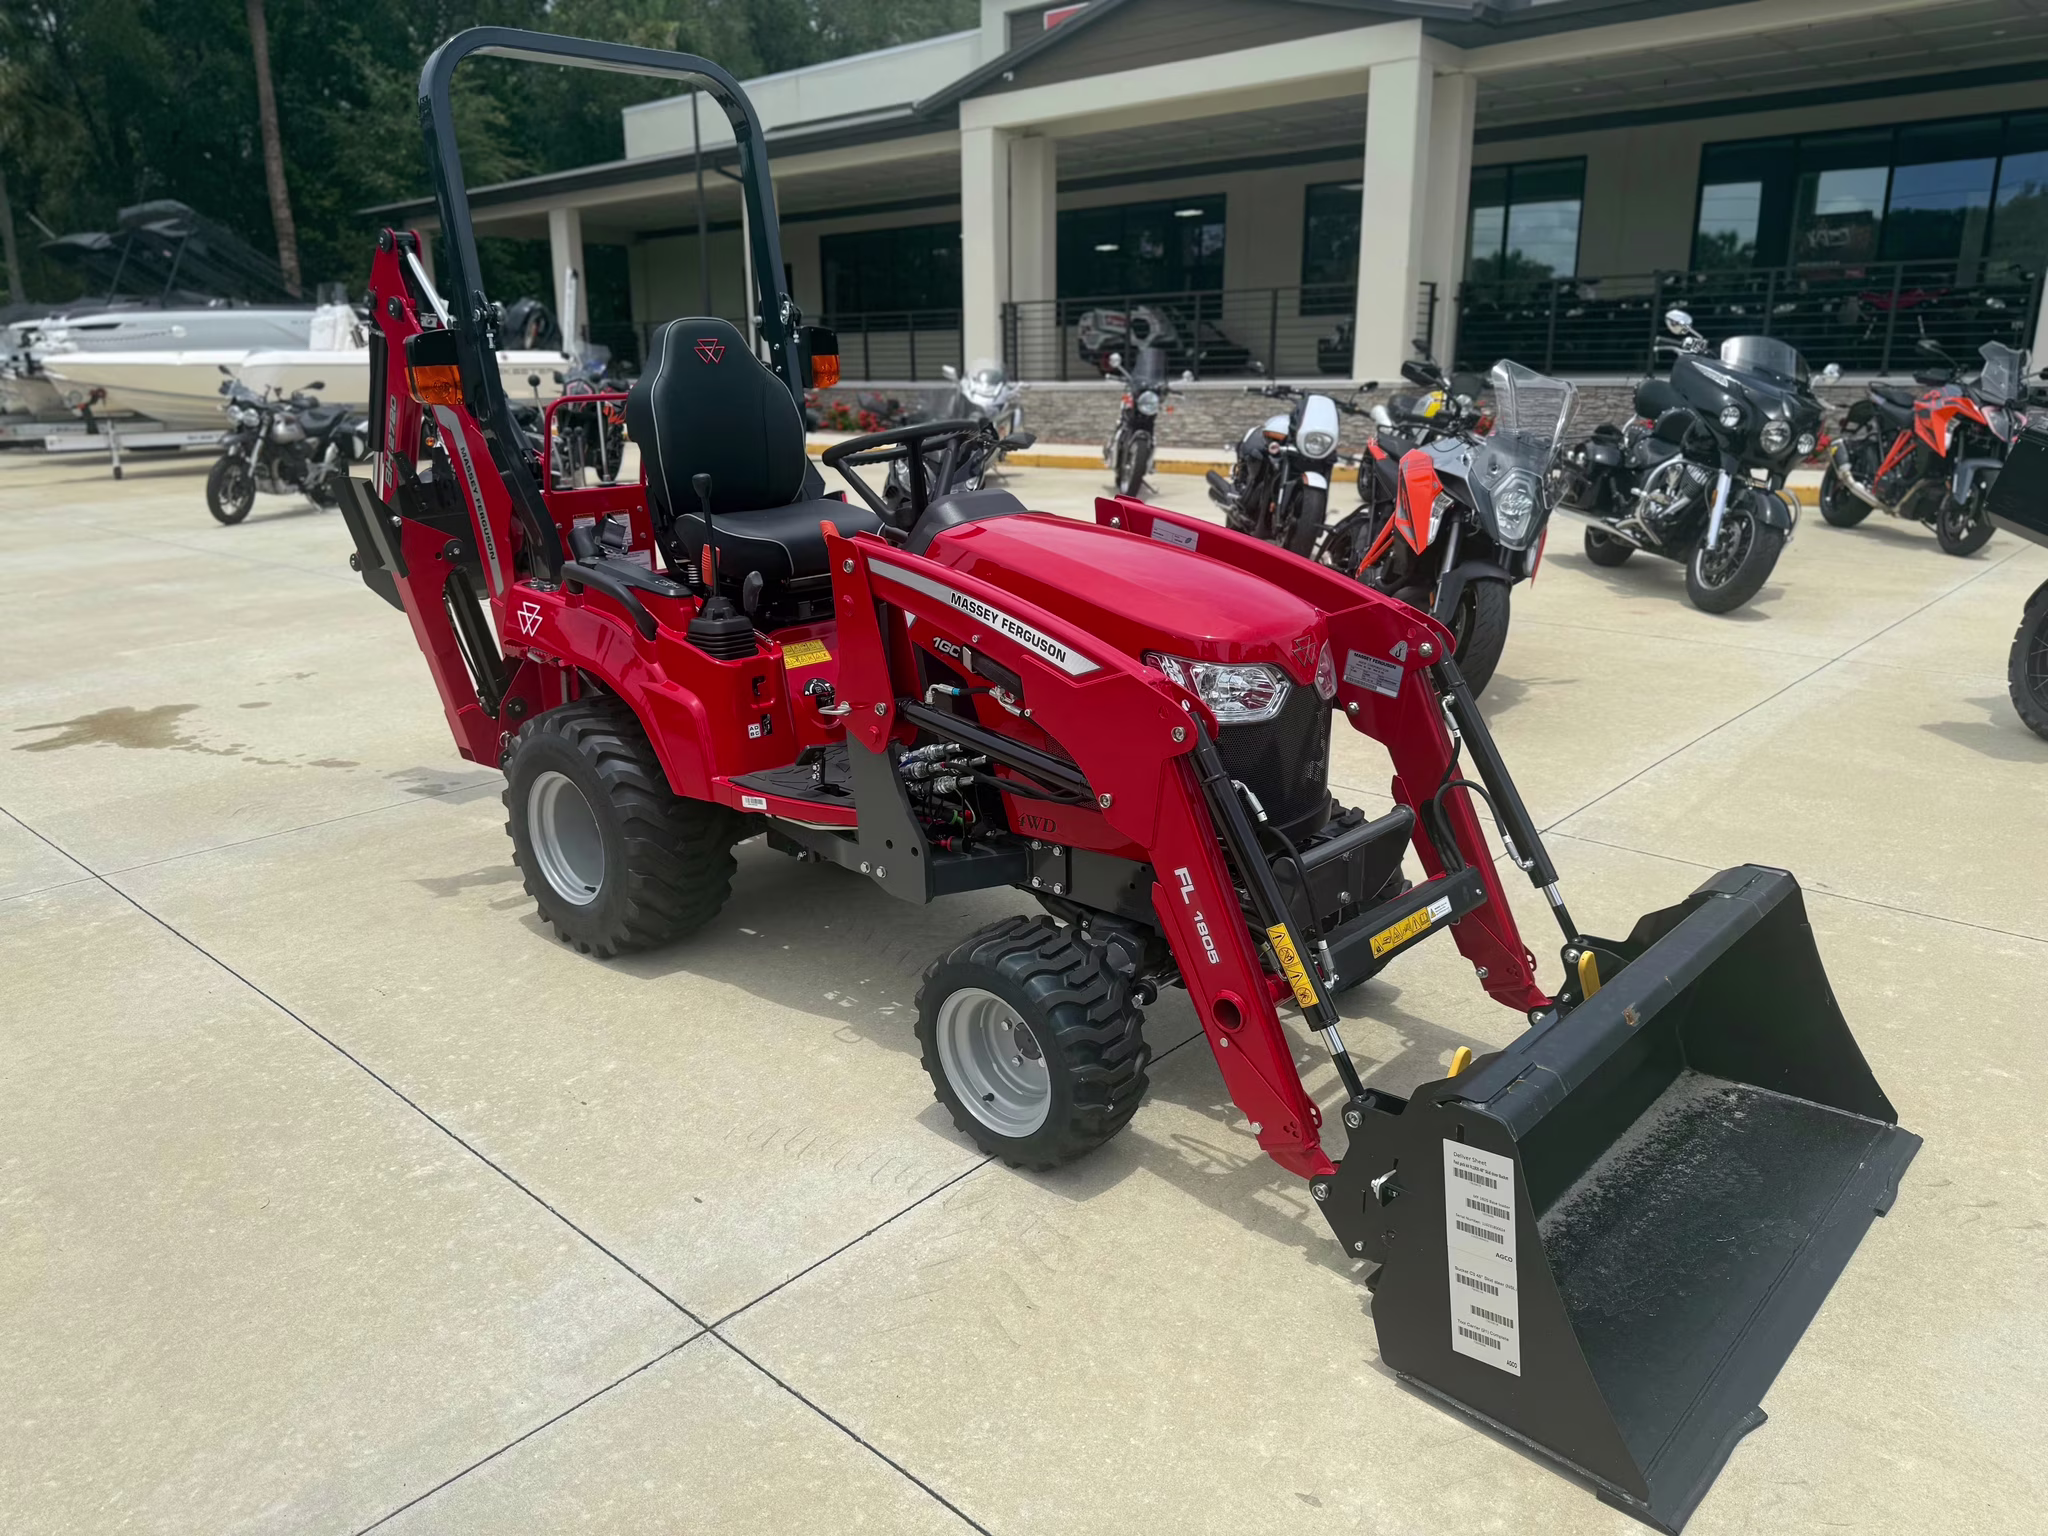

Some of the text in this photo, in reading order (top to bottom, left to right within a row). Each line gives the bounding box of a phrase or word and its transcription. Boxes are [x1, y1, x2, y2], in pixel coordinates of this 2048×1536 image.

[460, 447, 496, 560] MASSEY FERGUSON
[950, 592, 1067, 663] MASSEY FERGUSON
[1354, 652, 1372, 661] MASSEY
[1373, 659, 1396, 670] FERGUSON
[1017, 812, 1057, 833] 4WD
[1173, 866, 1220, 965] FL 1805
[1453, 1151, 1487, 1166] Deliver Sheet
[1495, 1252, 1513, 1263] AGCO
[1454, 1265, 1469, 1274] Bucket
[1489, 1330, 1509, 1342] Complete
[1506, 1359, 1518, 1369] AGCO
